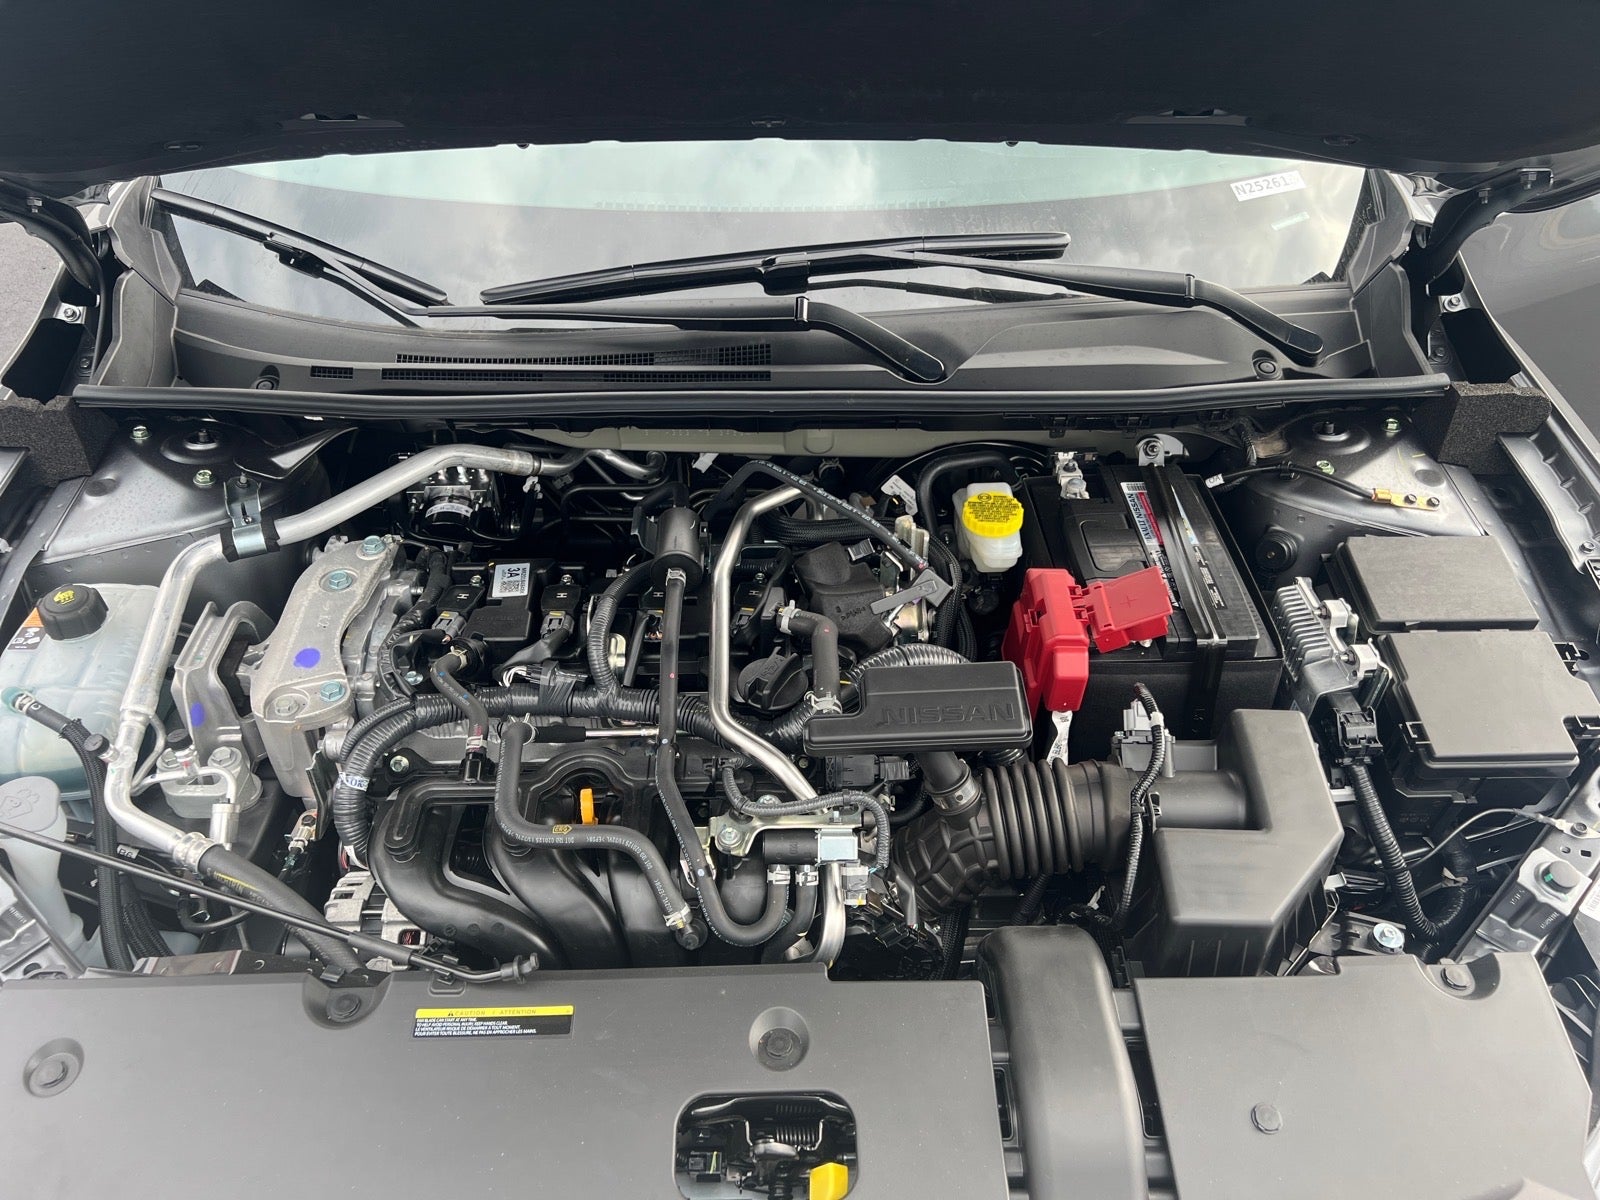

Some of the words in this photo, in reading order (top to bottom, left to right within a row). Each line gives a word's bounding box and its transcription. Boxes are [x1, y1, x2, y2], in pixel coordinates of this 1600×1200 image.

[1234, 176, 1290, 196] N25261
[1127, 493, 1142, 519] NISSAN
[507, 567, 520, 579] 3A
[881, 703, 1016, 725] NISSAN
